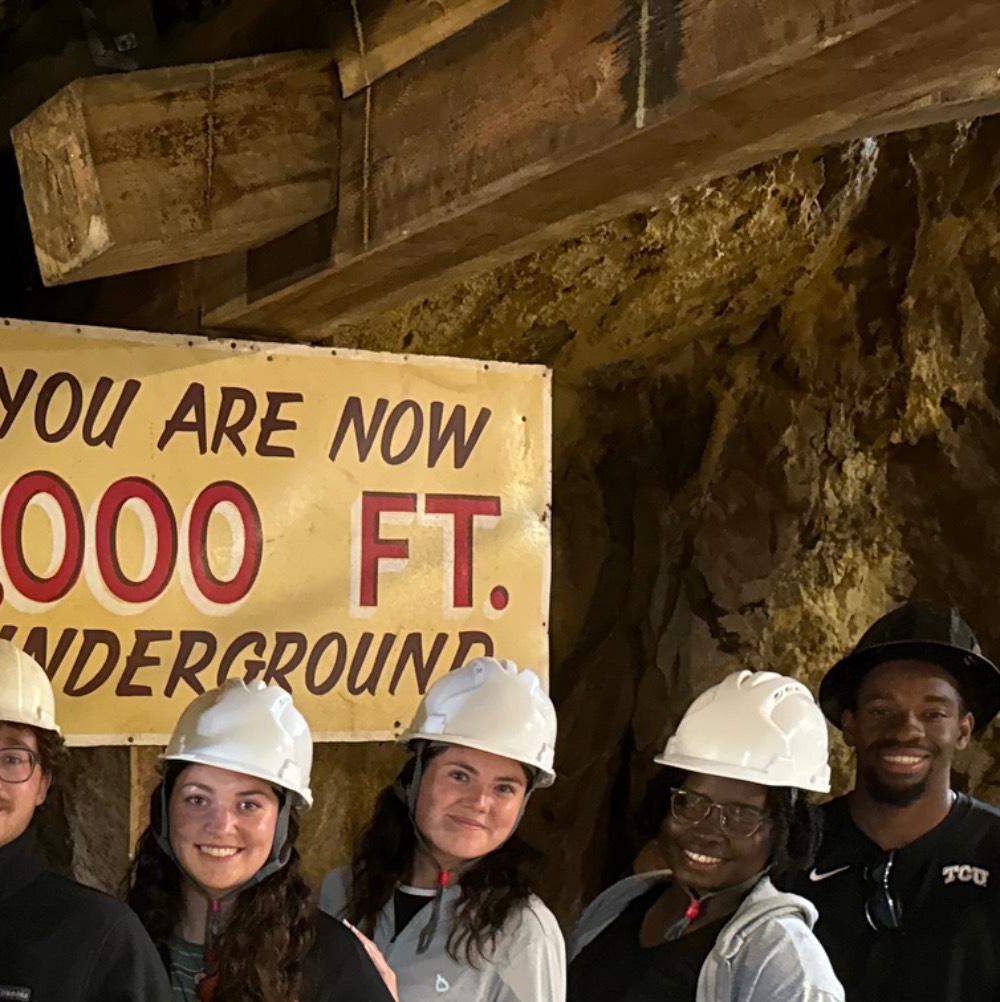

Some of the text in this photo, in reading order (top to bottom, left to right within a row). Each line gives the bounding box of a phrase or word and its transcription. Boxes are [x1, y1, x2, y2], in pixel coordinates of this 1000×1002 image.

[157, 382, 304, 458] ARE
[328, 396, 492, 469] NOW
[352, 491, 510, 613] FT.
[942, 865, 990, 887] TCU
